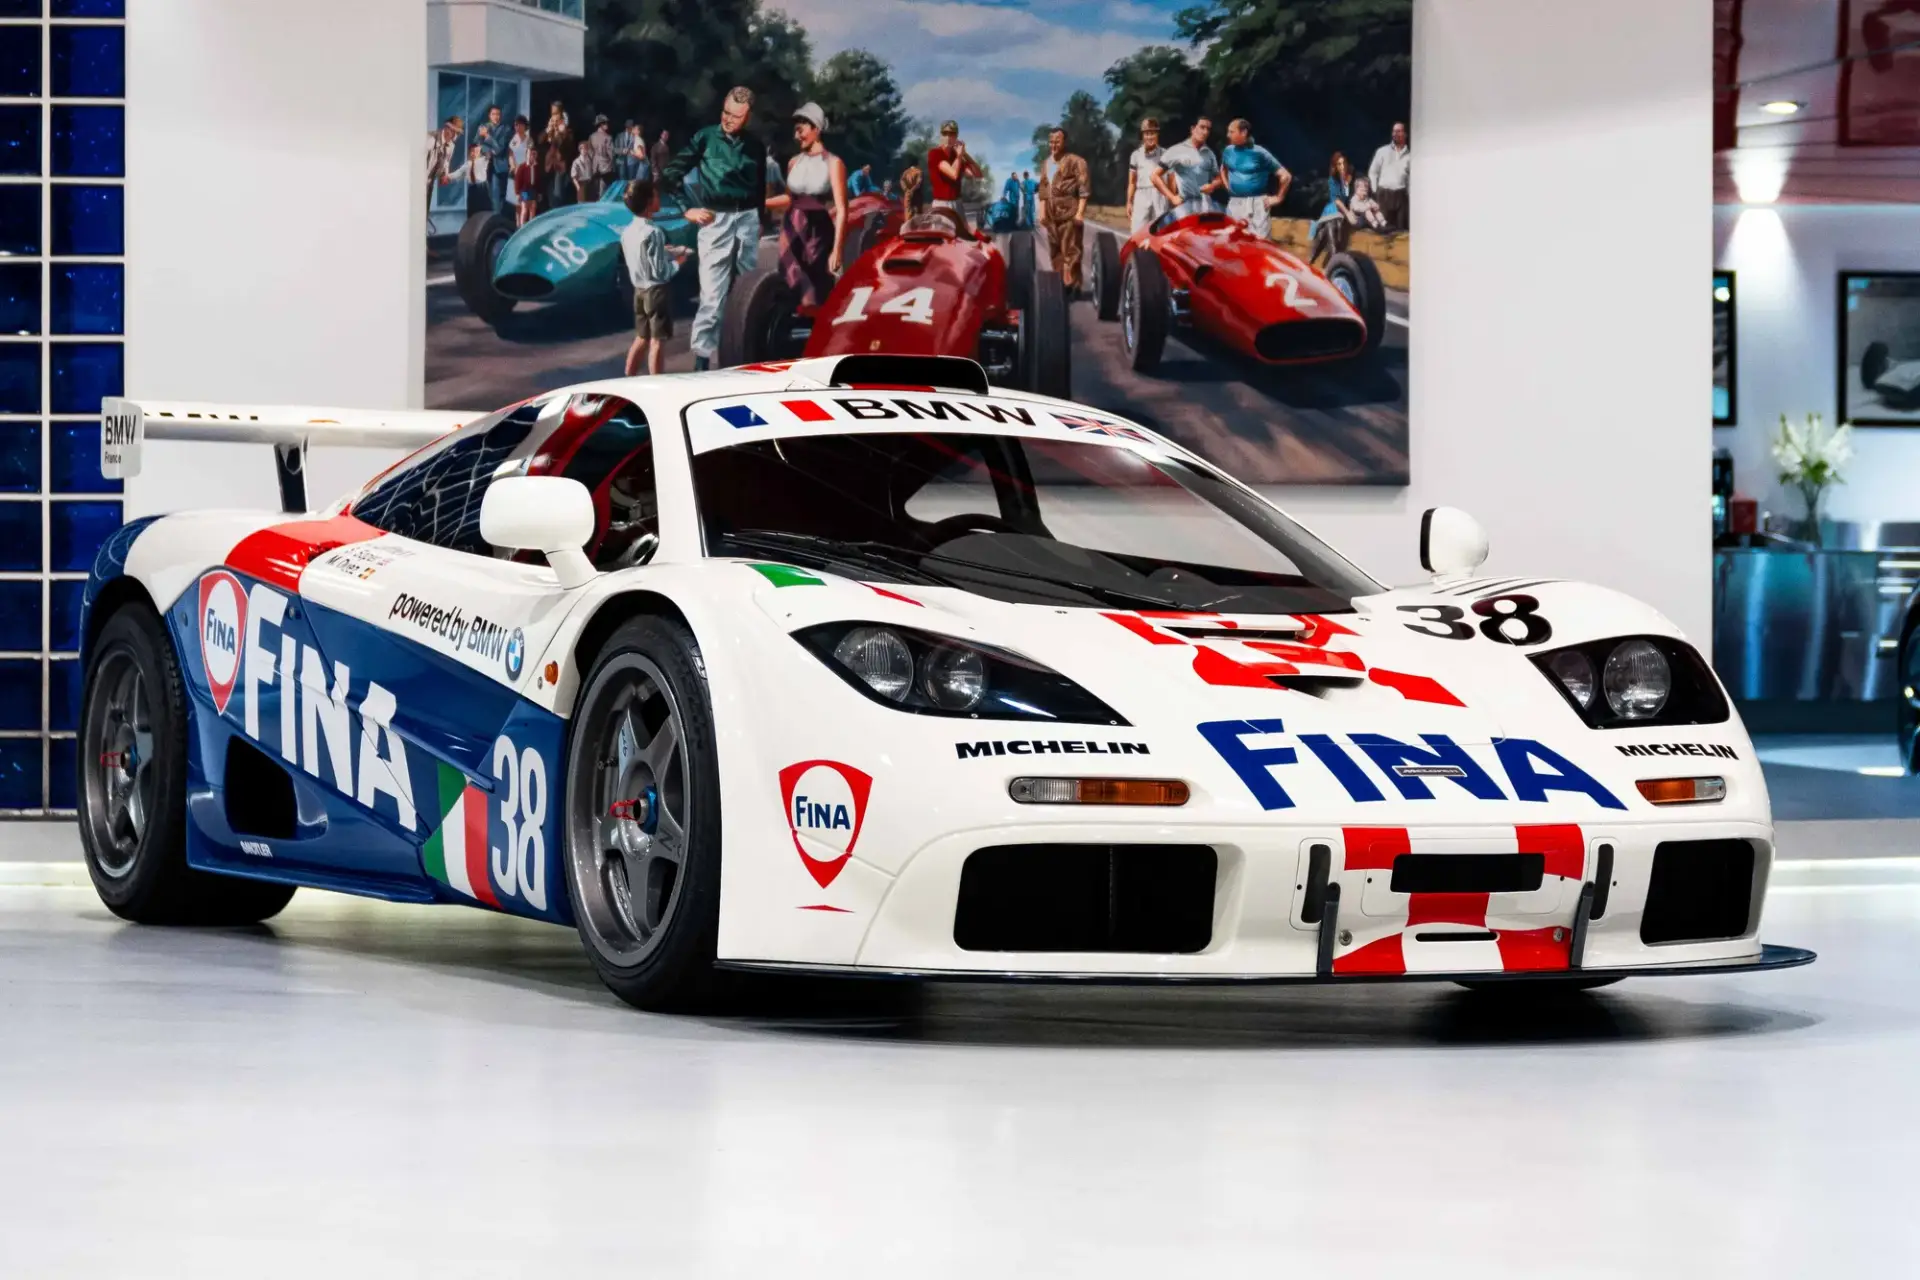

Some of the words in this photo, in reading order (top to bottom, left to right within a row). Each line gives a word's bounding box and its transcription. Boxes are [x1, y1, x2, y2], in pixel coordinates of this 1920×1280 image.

[541, 236, 588, 267] 18
[832, 286, 935, 326] 14
[1265, 272, 1318, 307] 2
[105, 414, 137, 445] BMW
[831, 398, 1036, 426] BMW
[205, 608, 236, 656] FINA
[388, 592, 457, 637] powered
[449, 608, 469, 651] by
[467, 616, 507, 662] BMW
[1396, 594, 1552, 646] 38
[245, 582, 418, 833] FINA
[955, 740, 1150, 759] MICHELIN
[1196, 718, 1629, 811] FINA
[1614, 743, 1740, 760] MICHELIN
[492, 734, 547, 911] 38
[796, 796, 851, 830] FINA
